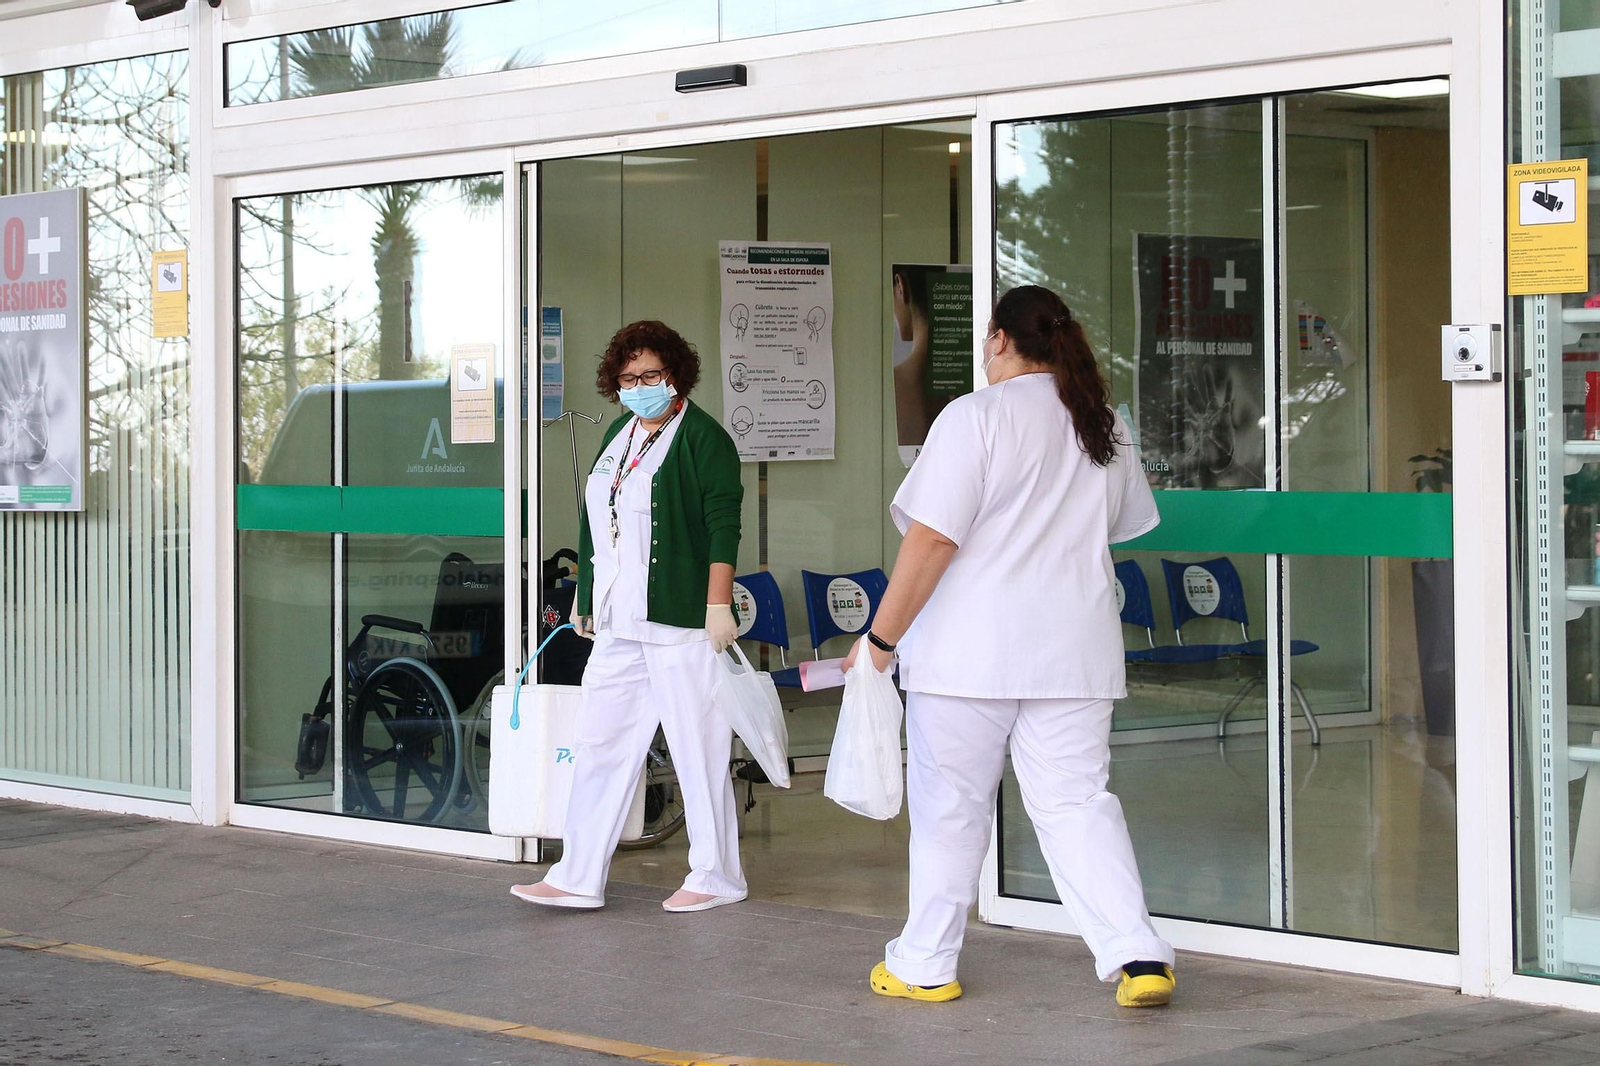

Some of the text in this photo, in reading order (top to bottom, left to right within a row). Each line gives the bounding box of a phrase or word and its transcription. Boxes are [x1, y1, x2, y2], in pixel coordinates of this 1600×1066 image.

[1532, 166, 1581, 175] VIDEOVIGILADA
[750, 266, 772, 275] tosas
[778, 267, 825, 276] estornudes
[0, 278, 67, 312] ESIONES
[0, 313, 67, 333] ONAL DE SANIDAD
[1155, 341, 1253, 355] AL PERSONAL DE SANIDAD
[406, 462, 467, 473] Junta de Andalucía
